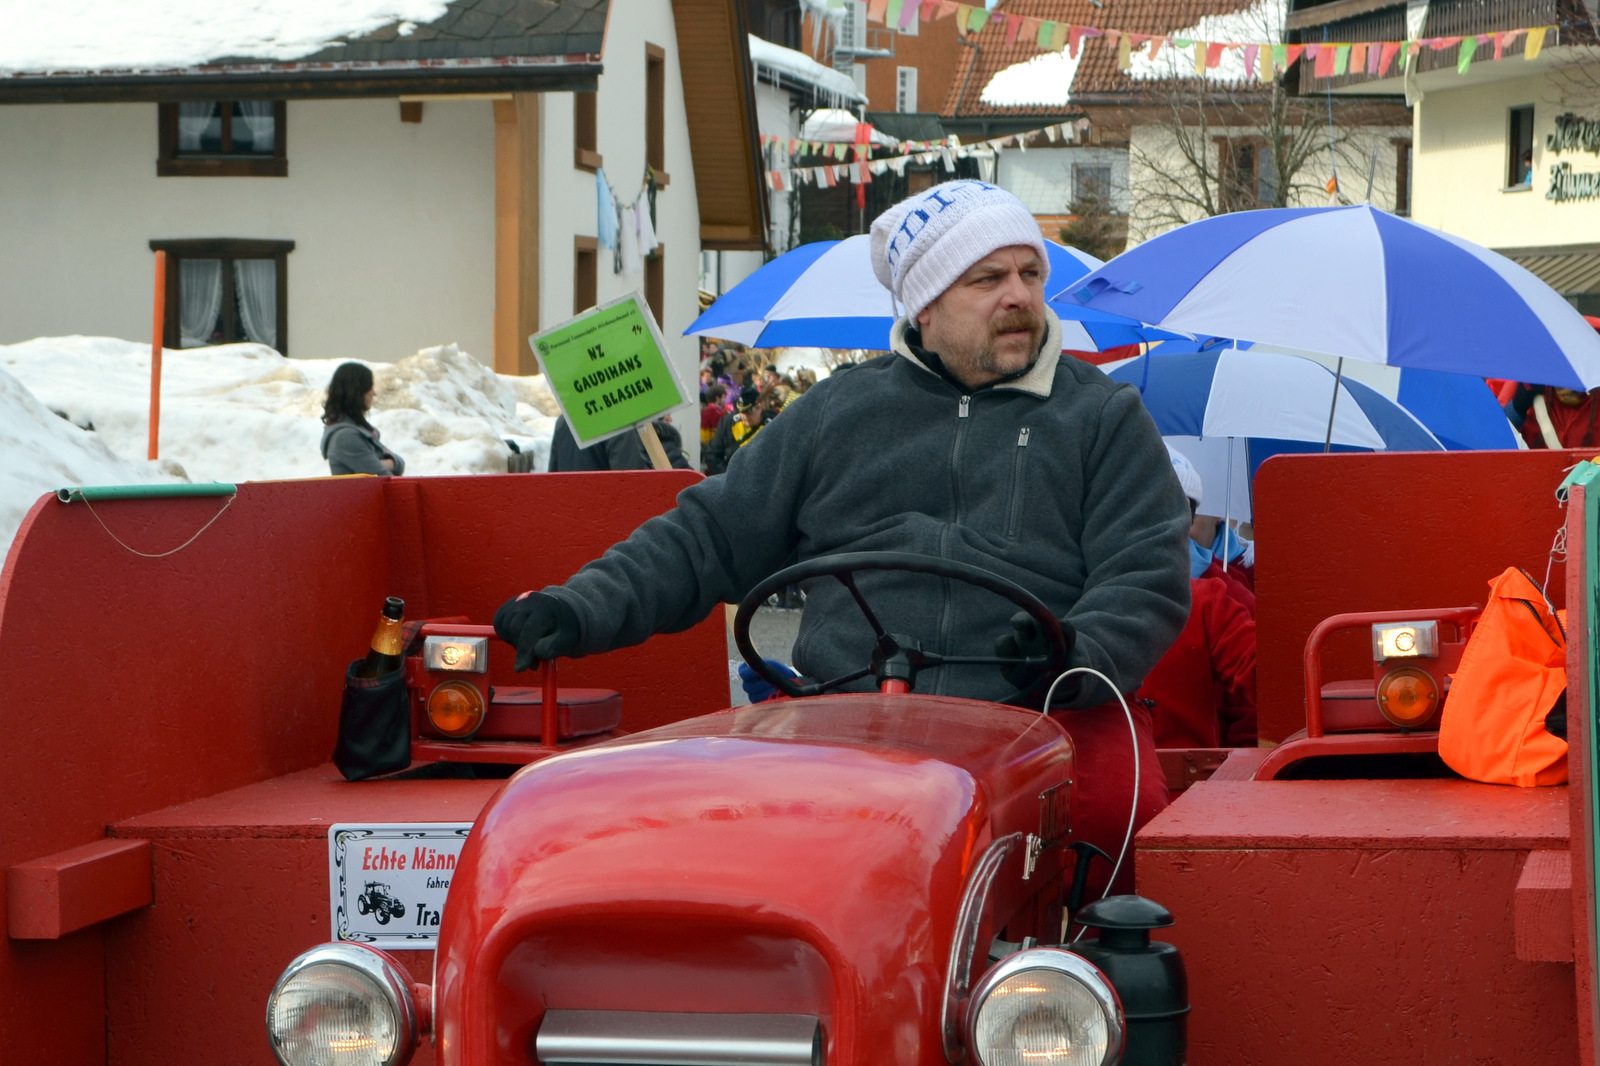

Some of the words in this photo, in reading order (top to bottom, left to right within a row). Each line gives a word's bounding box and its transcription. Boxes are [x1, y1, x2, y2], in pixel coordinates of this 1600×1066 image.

[587, 344, 605, 361] NZ
[573, 354, 642, 394] GAUDIHANS
[584, 401, 604, 416] ST.
[602, 376, 653, 409] BLASIEN
[362, 846, 407, 871] Echte
[411, 846, 456, 871] Männ
[426, 876, 450, 889] fahre
[416, 903, 446, 927] Tra
